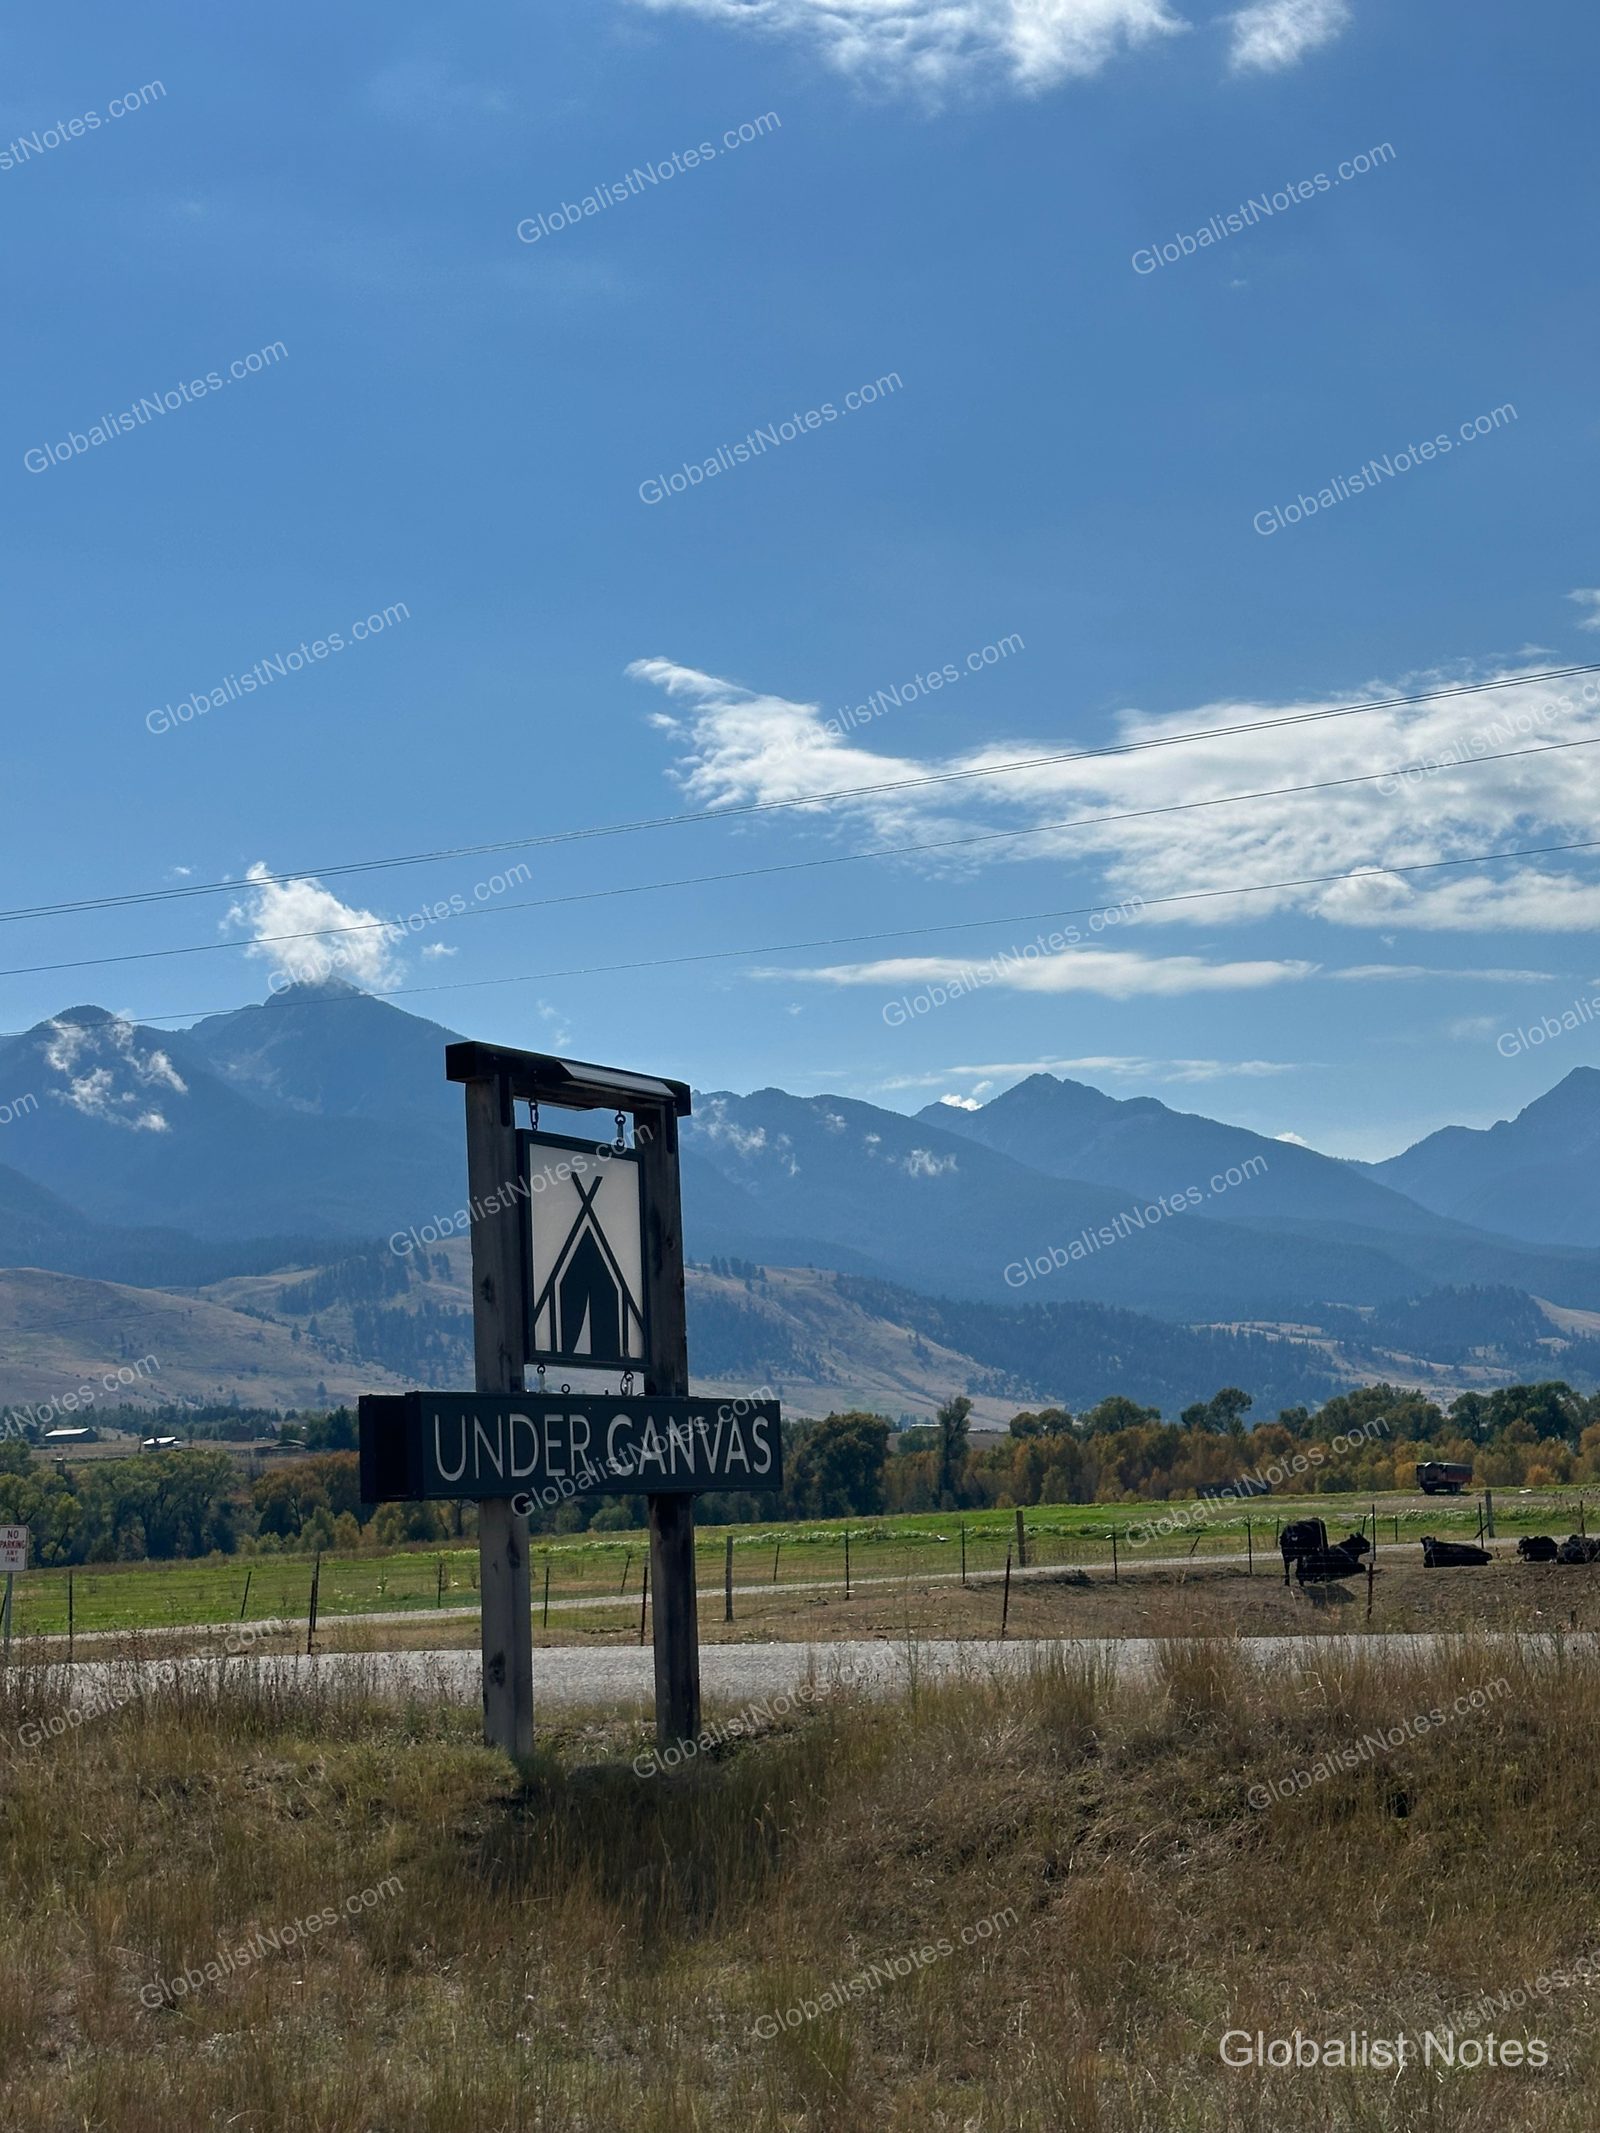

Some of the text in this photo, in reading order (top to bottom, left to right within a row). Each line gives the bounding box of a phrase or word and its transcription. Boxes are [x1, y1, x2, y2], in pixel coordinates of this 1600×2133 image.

[433, 1413, 772, 1481] UNDER CANVAS
[7, 1530, 19, 1539] NO
[0, 1540, 25, 1549] PARKING
